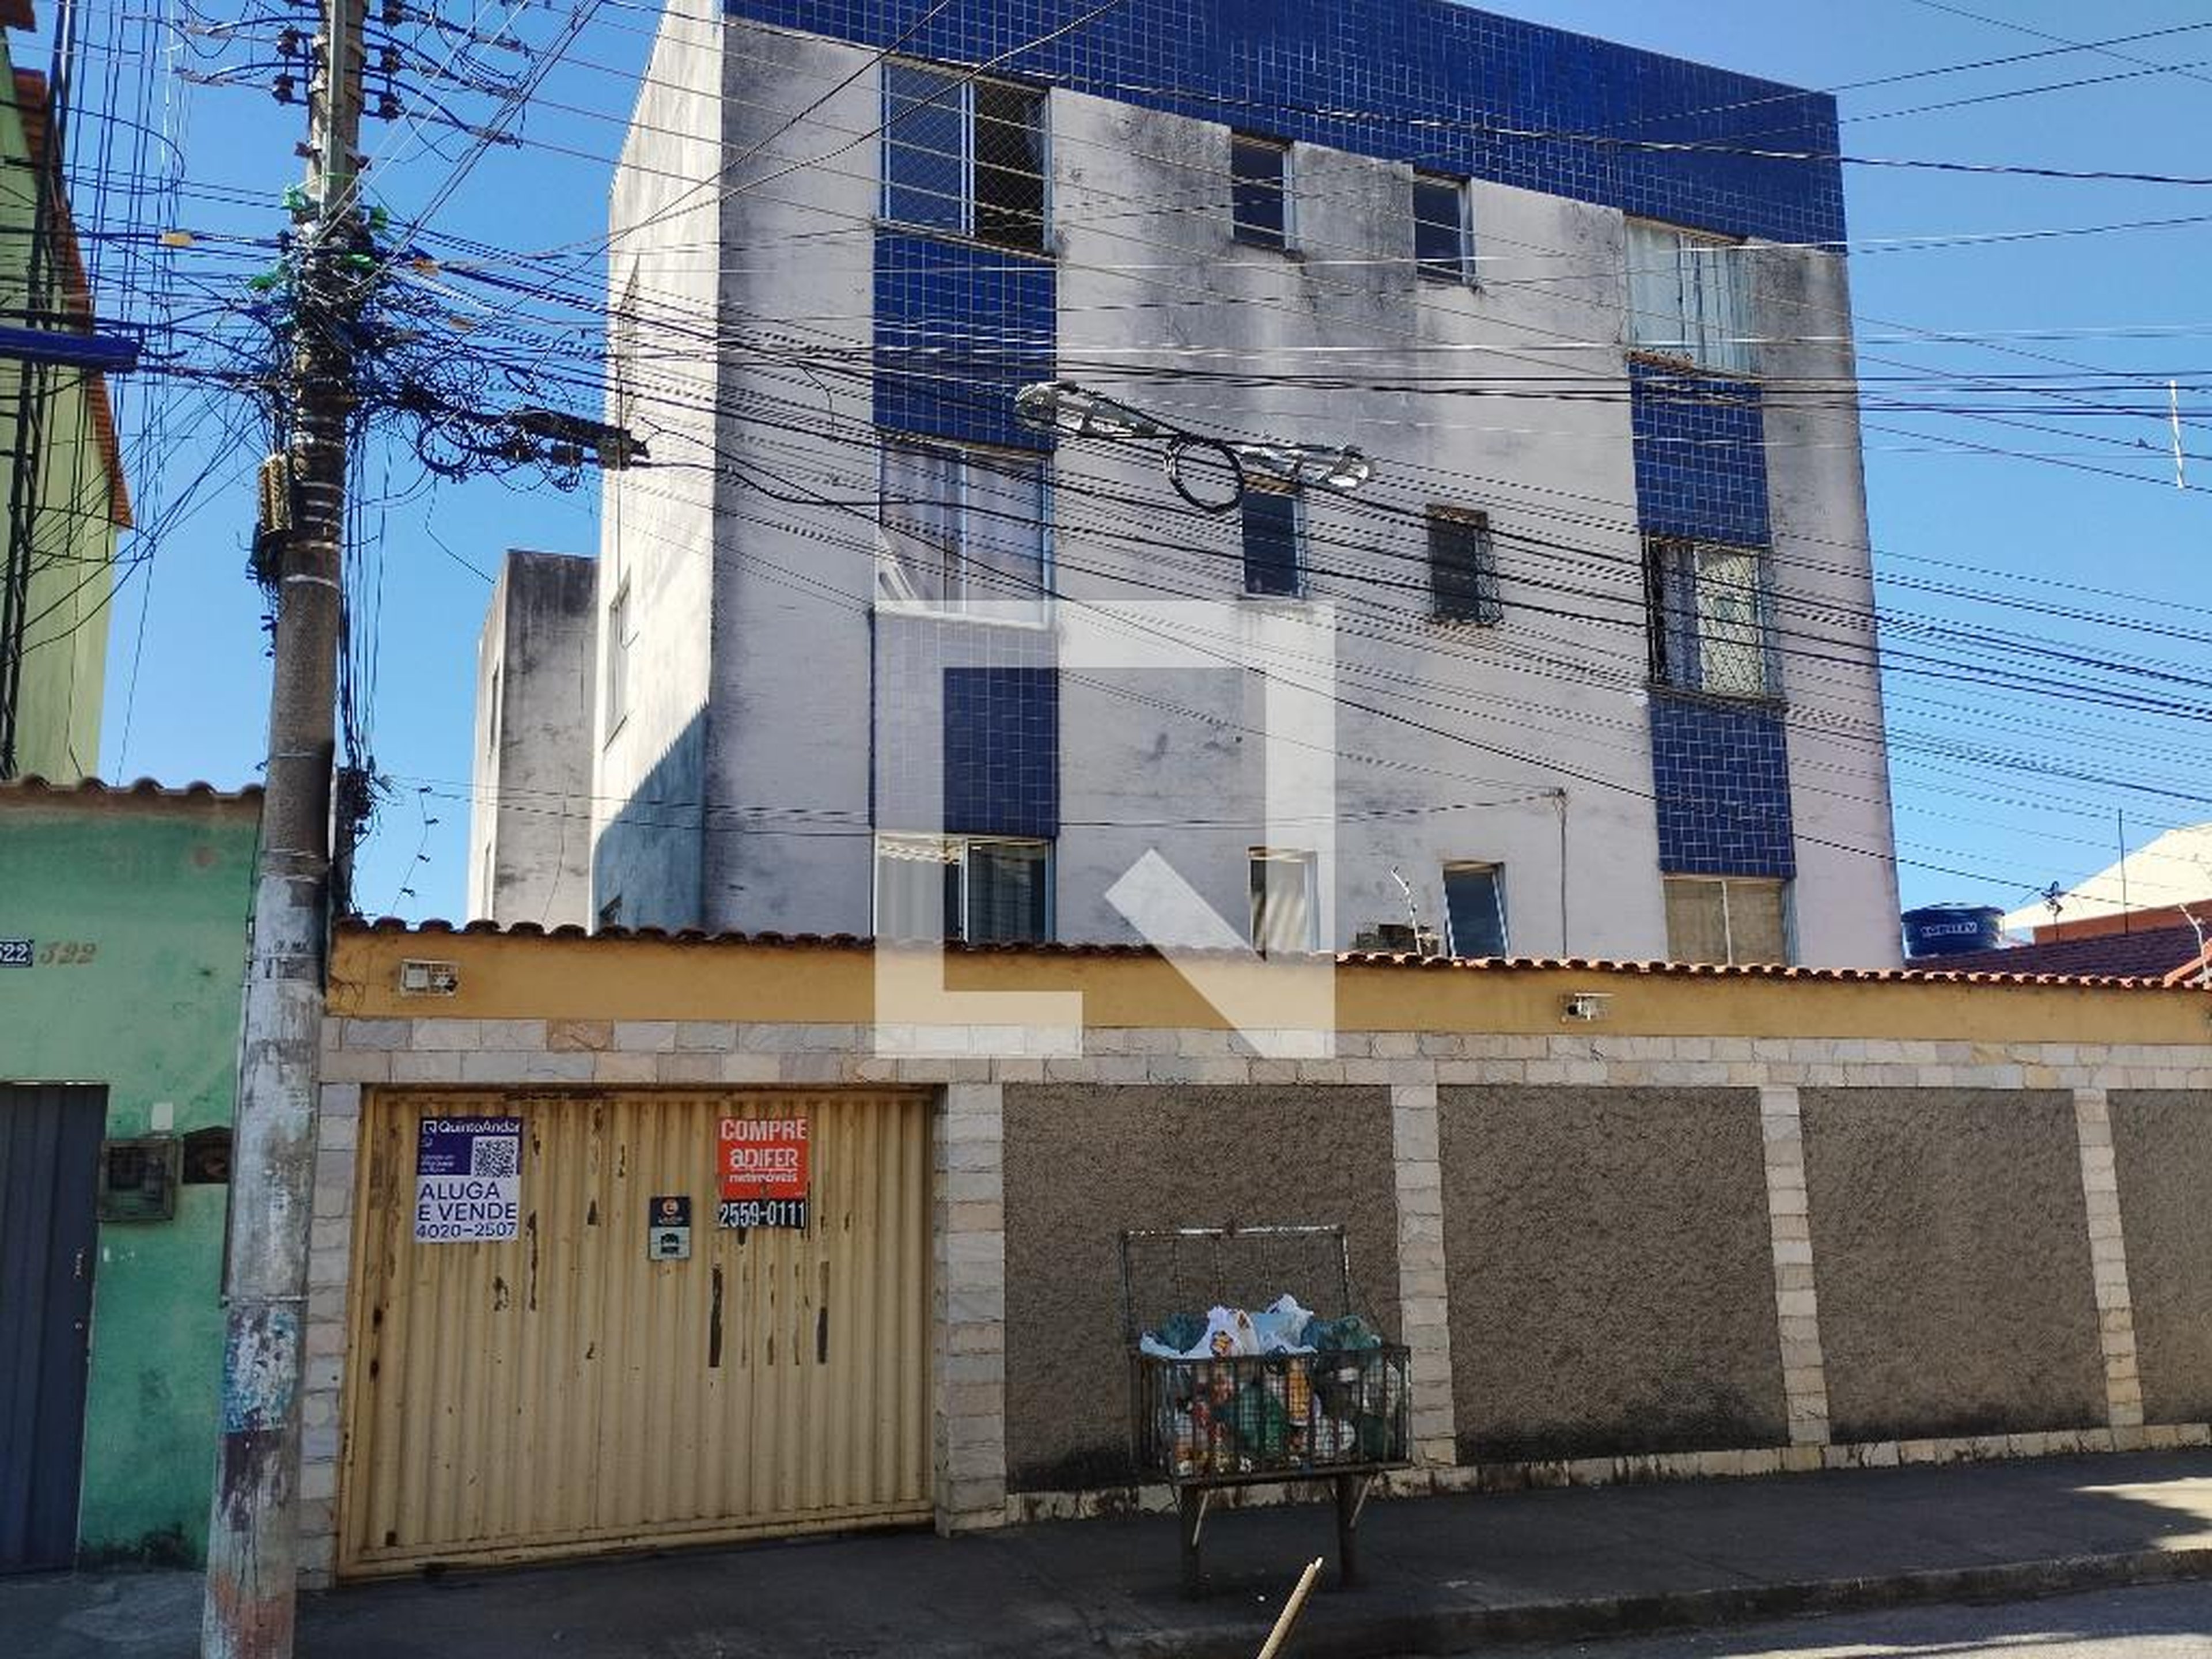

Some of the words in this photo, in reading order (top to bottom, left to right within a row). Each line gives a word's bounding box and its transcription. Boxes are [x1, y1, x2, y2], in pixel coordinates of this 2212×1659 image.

[0, 943, 28, 962] 22
[438, 1120, 520, 1133] QuintoAndar
[721, 1119, 807, 1141] COMPRE
[419, 1181, 501, 1200] ALUGA
[418, 1204, 431, 1222] E
[438, 1202, 517, 1221] VENDE
[719, 1200, 805, 1228] 2559-0111
[416, 1222, 517, 1238] 4020-2507
